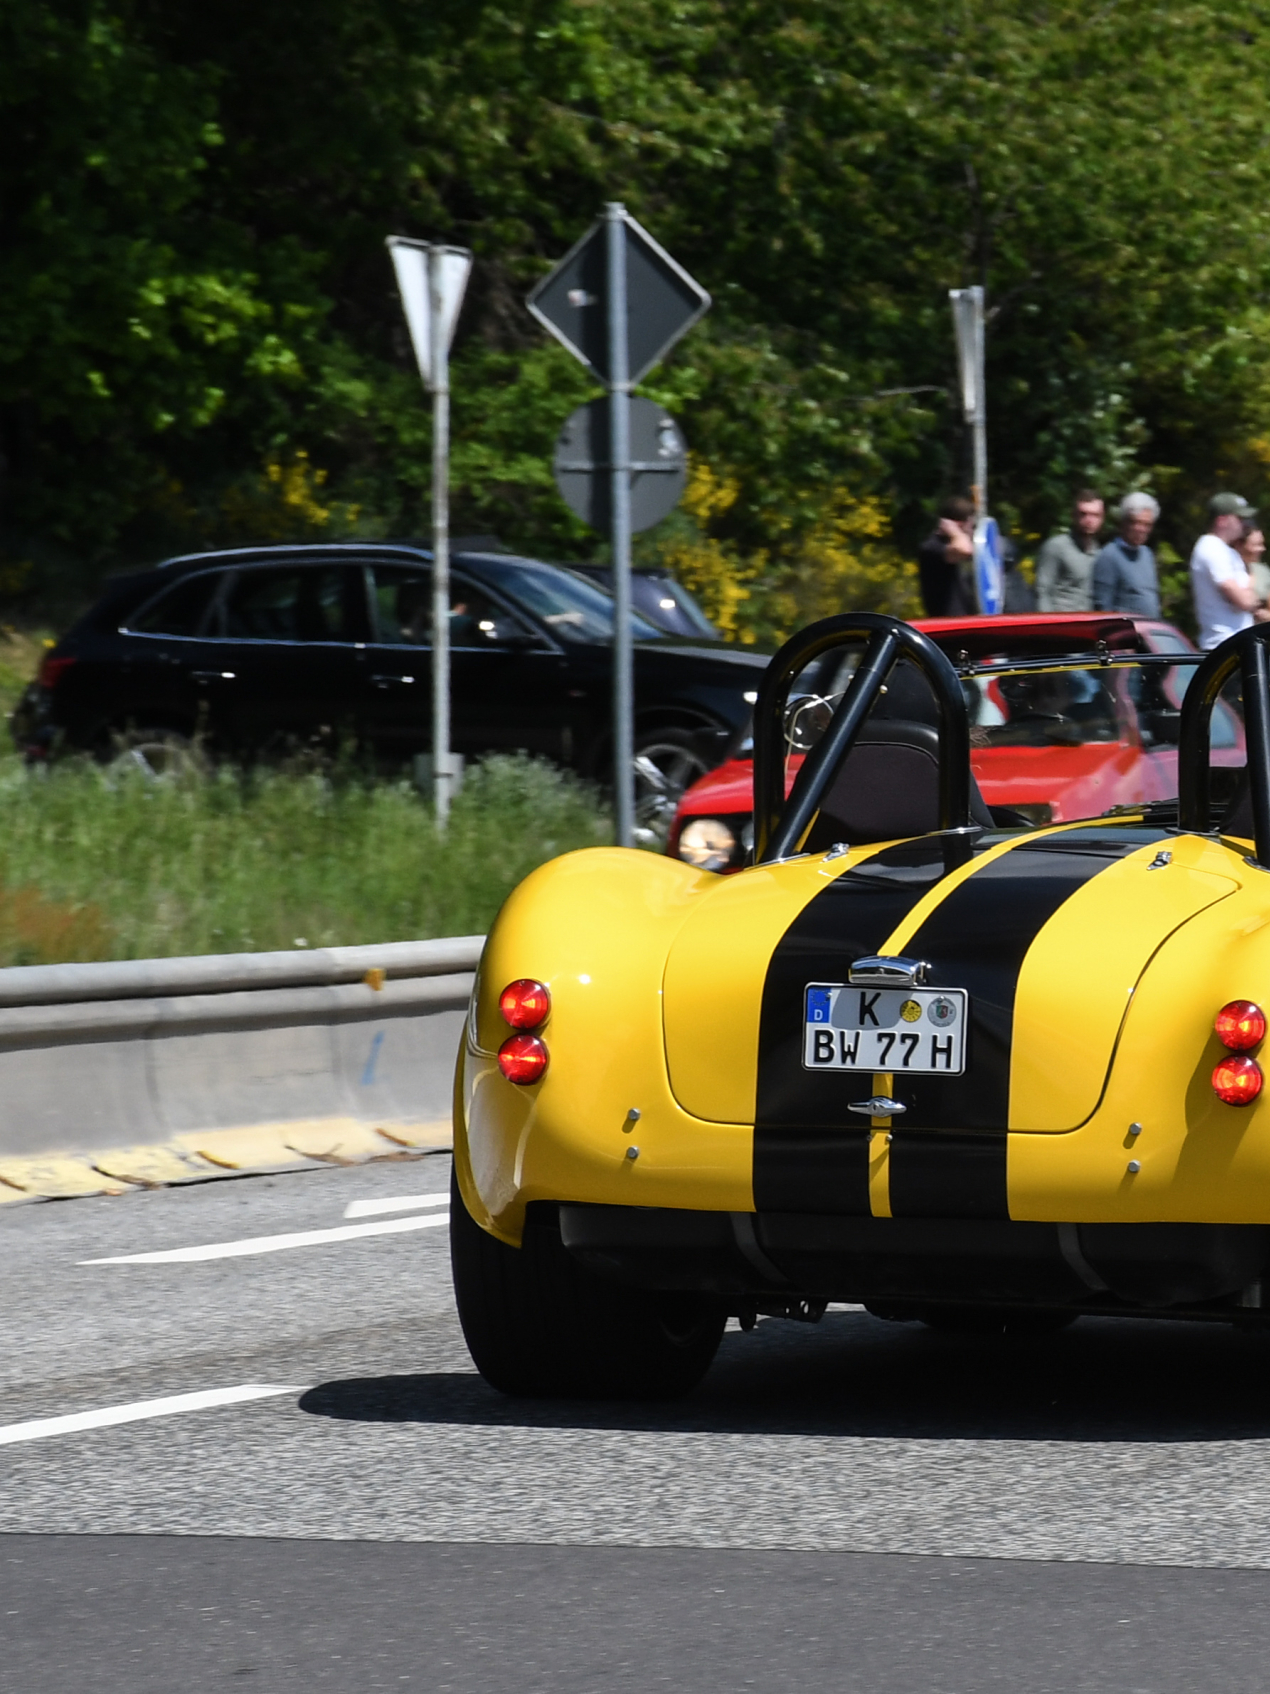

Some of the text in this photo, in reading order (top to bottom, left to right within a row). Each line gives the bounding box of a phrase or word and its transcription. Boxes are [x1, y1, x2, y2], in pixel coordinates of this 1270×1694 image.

[813, 1009, 824, 1021] D
[858, 991, 882, 1027] K
[813, 1029, 953, 1069] BW 77 H
